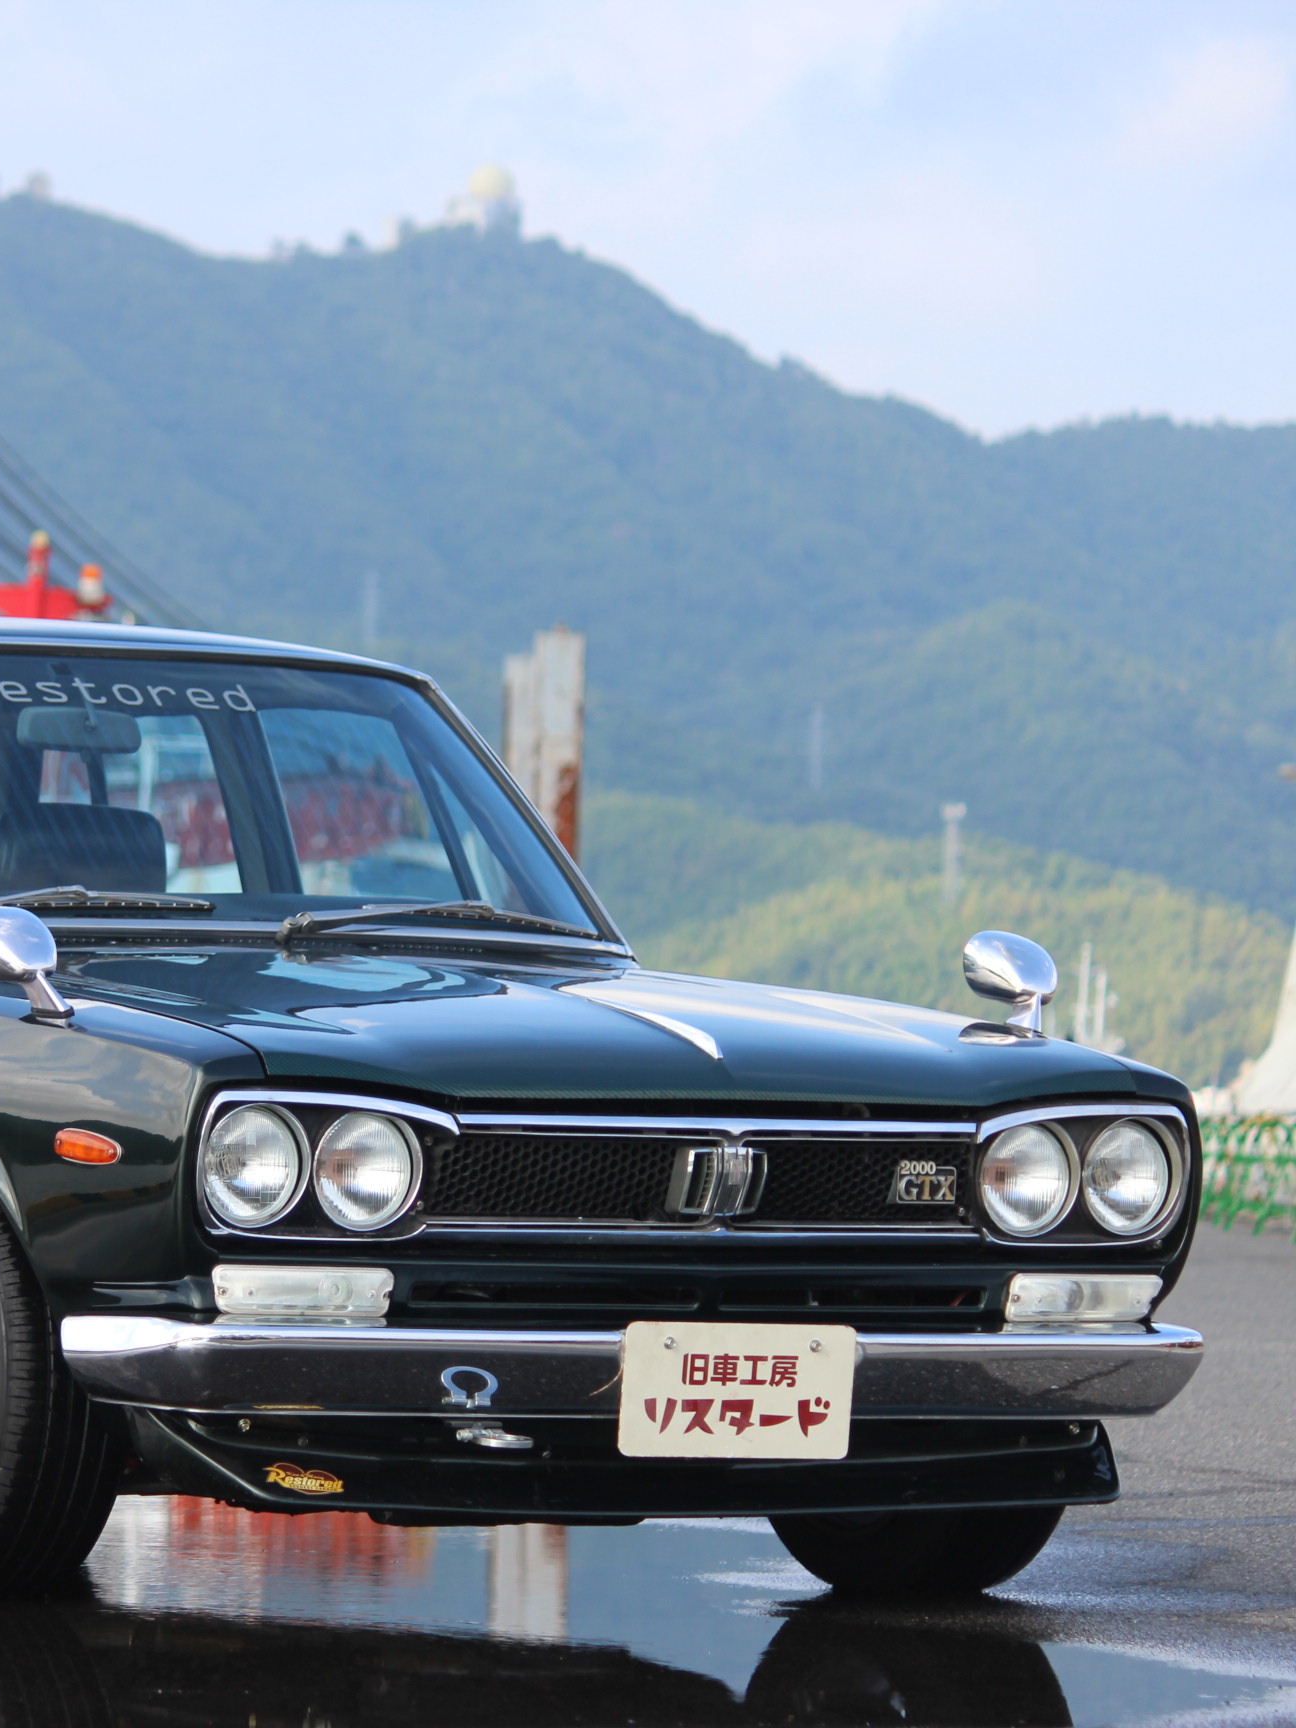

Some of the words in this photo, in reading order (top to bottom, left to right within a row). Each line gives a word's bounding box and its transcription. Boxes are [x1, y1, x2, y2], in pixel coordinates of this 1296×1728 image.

[900, 1161, 936, 1175] 2000
[898, 1175, 955, 1201] GTX
[681, 1353, 799, 1388] 旧車工房
[644, 1397, 831, 1438] リスタード
[263, 1466, 344, 1492] Restored
